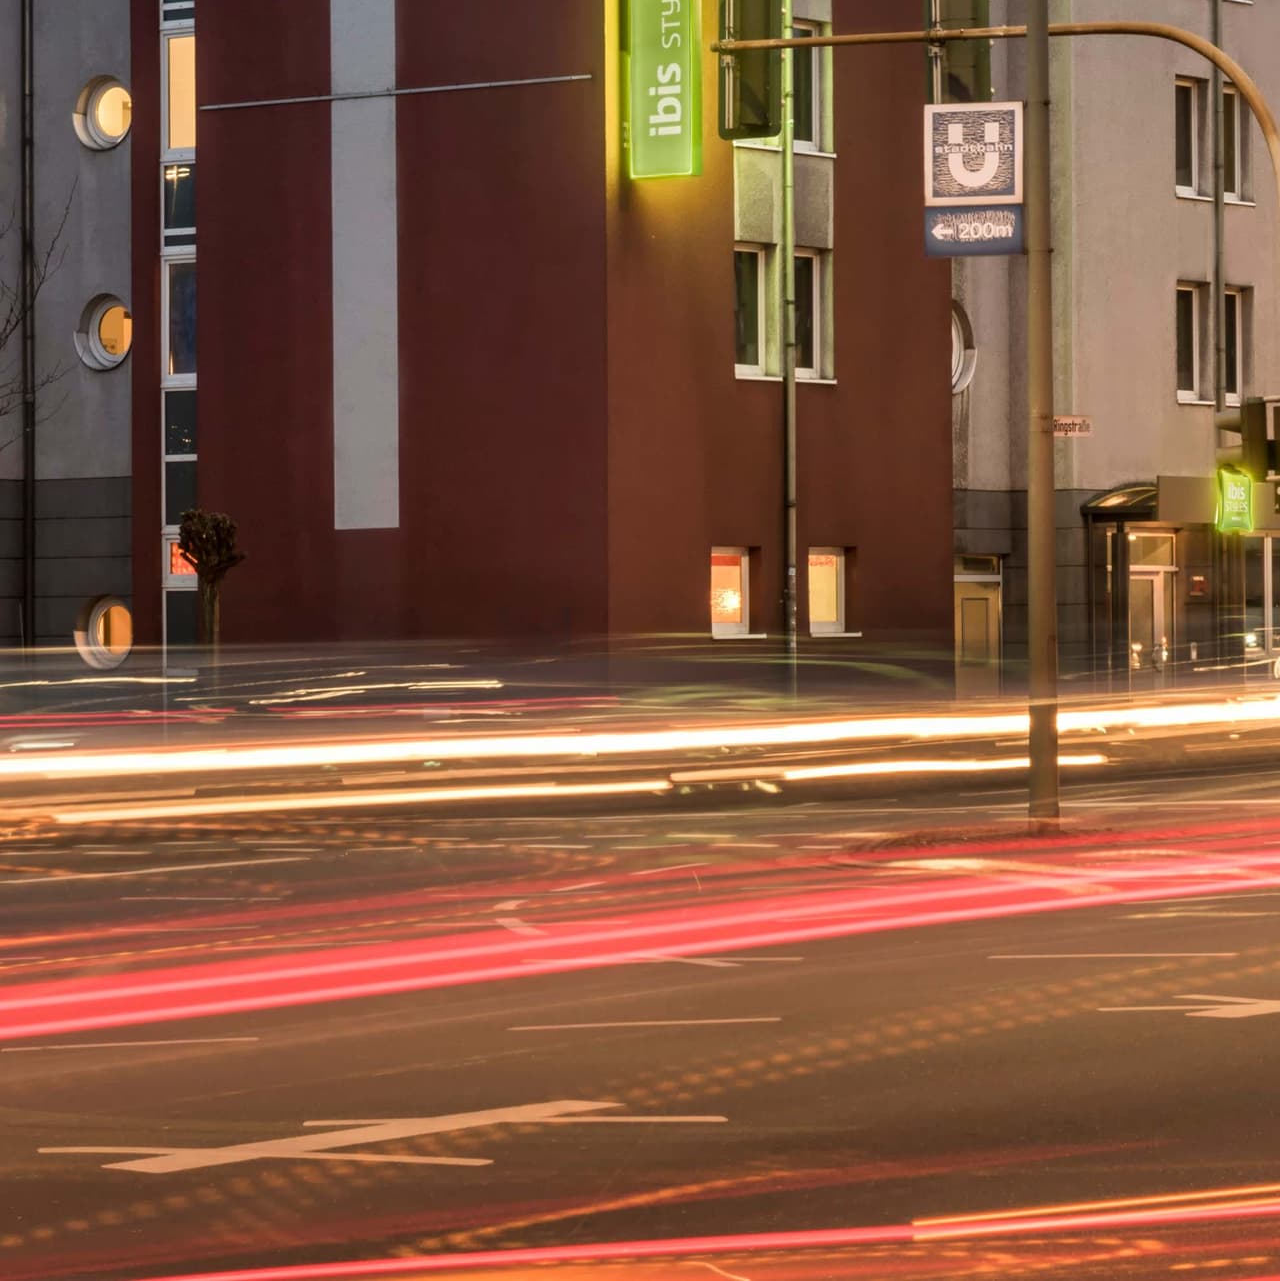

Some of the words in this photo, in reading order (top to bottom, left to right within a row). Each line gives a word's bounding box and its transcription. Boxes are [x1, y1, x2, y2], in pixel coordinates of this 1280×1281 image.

[648, 62, 682, 136] ibis
[934, 141, 1013, 154] stadtbahn
[959, 222, 1014, 239] 200m
[1228, 482, 1246, 499] ibis
